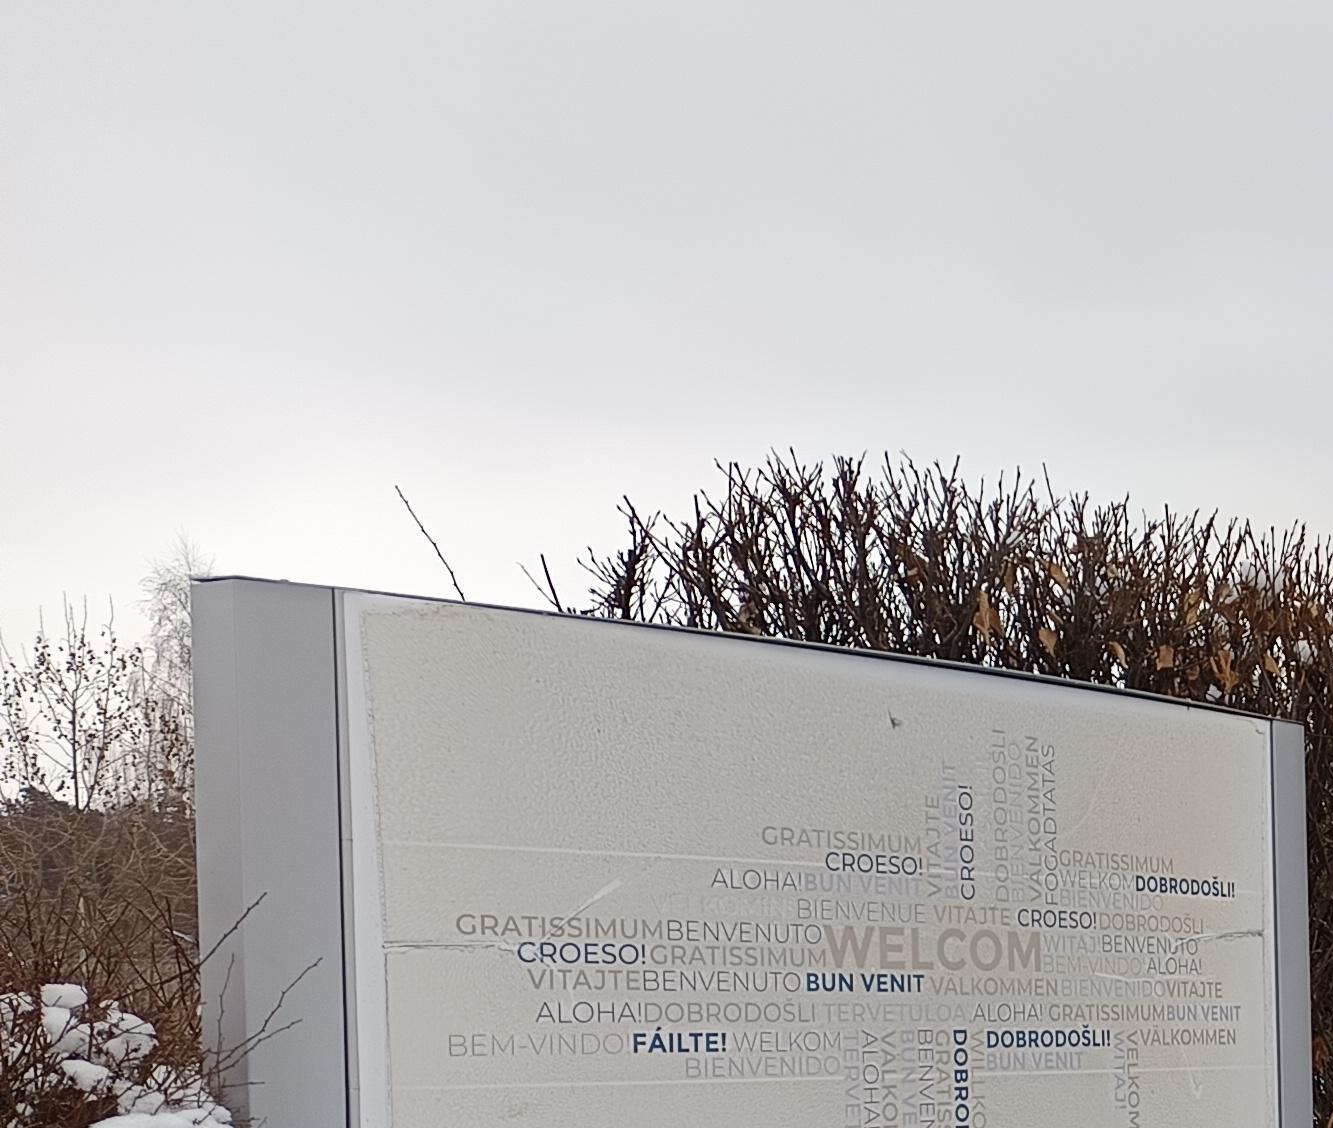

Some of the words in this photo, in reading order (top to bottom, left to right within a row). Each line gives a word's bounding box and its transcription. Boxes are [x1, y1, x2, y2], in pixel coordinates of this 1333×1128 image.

[761, 826, 921, 853] GRATISSIMUM
[925, 794, 942, 897] VITAJTE
[958, 784, 975, 901] CROESO!
[825, 852, 923, 876] CROESO!
[1059, 850, 1174, 874] GRATISSIMUM
[711, 868, 802, 892] ALOHA!
[804, 872, 850, 893] BUN
[859, 875, 921, 896] VENIT
[1059, 869, 1135, 891] WELKOM
[1135, 875, 1236, 898] DOBRODOŠLI!
[797, 898, 927, 924] BIENVENUE
[1060, 889, 1164, 911] BIENVENIDO
[455, 913, 663, 940] GRATISSIMUM
[934, 904, 1011, 926] VITAJTE
[1017, 909, 1097, 930] CROESO!
[667, 919, 822, 944] BENVENUTO
[517, 941, 646, 965] CROESO!
[650, 944, 827, 968] GRATISSIMUM
[823, 925, 1042, 973] WELCOM
[1101, 934, 1199, 956] BENVENUTO
[1146, 957, 1202, 976] ALOHA!
[527, 968, 641, 991] VITAJTE
[643, 969, 801, 992] BENVENUTO
[806, 972, 854, 992] BUN
[861, 973, 925, 993] VENIT
[1062, 979, 1165, 998] BIENVENIDO
[1165, 980, 1223, 999] VITAJTE
[535, 1001, 642, 1023] ALOHA!
[644, 998, 816, 1023] DOBRODOŠLI
[1048, 1003, 1165, 1021] GRATISSIMUM
[1166, 1004, 1198, 1021] BUN
[1200, 1005, 1241, 1022] VENIT
[448, 1033, 629, 1057] BEM-VINDO!
[632, 1026, 727, 1054] FÁILTE!
[732, 1031, 842, 1053] WELKOM
[986, 1025, 1111, 1048] DOBRODOŠLI!
[685, 1056, 841, 1079] BIENVENIDO
[987, 1051, 1029, 1072] BUN
[1033, 1050, 1084, 1071] VENIT
